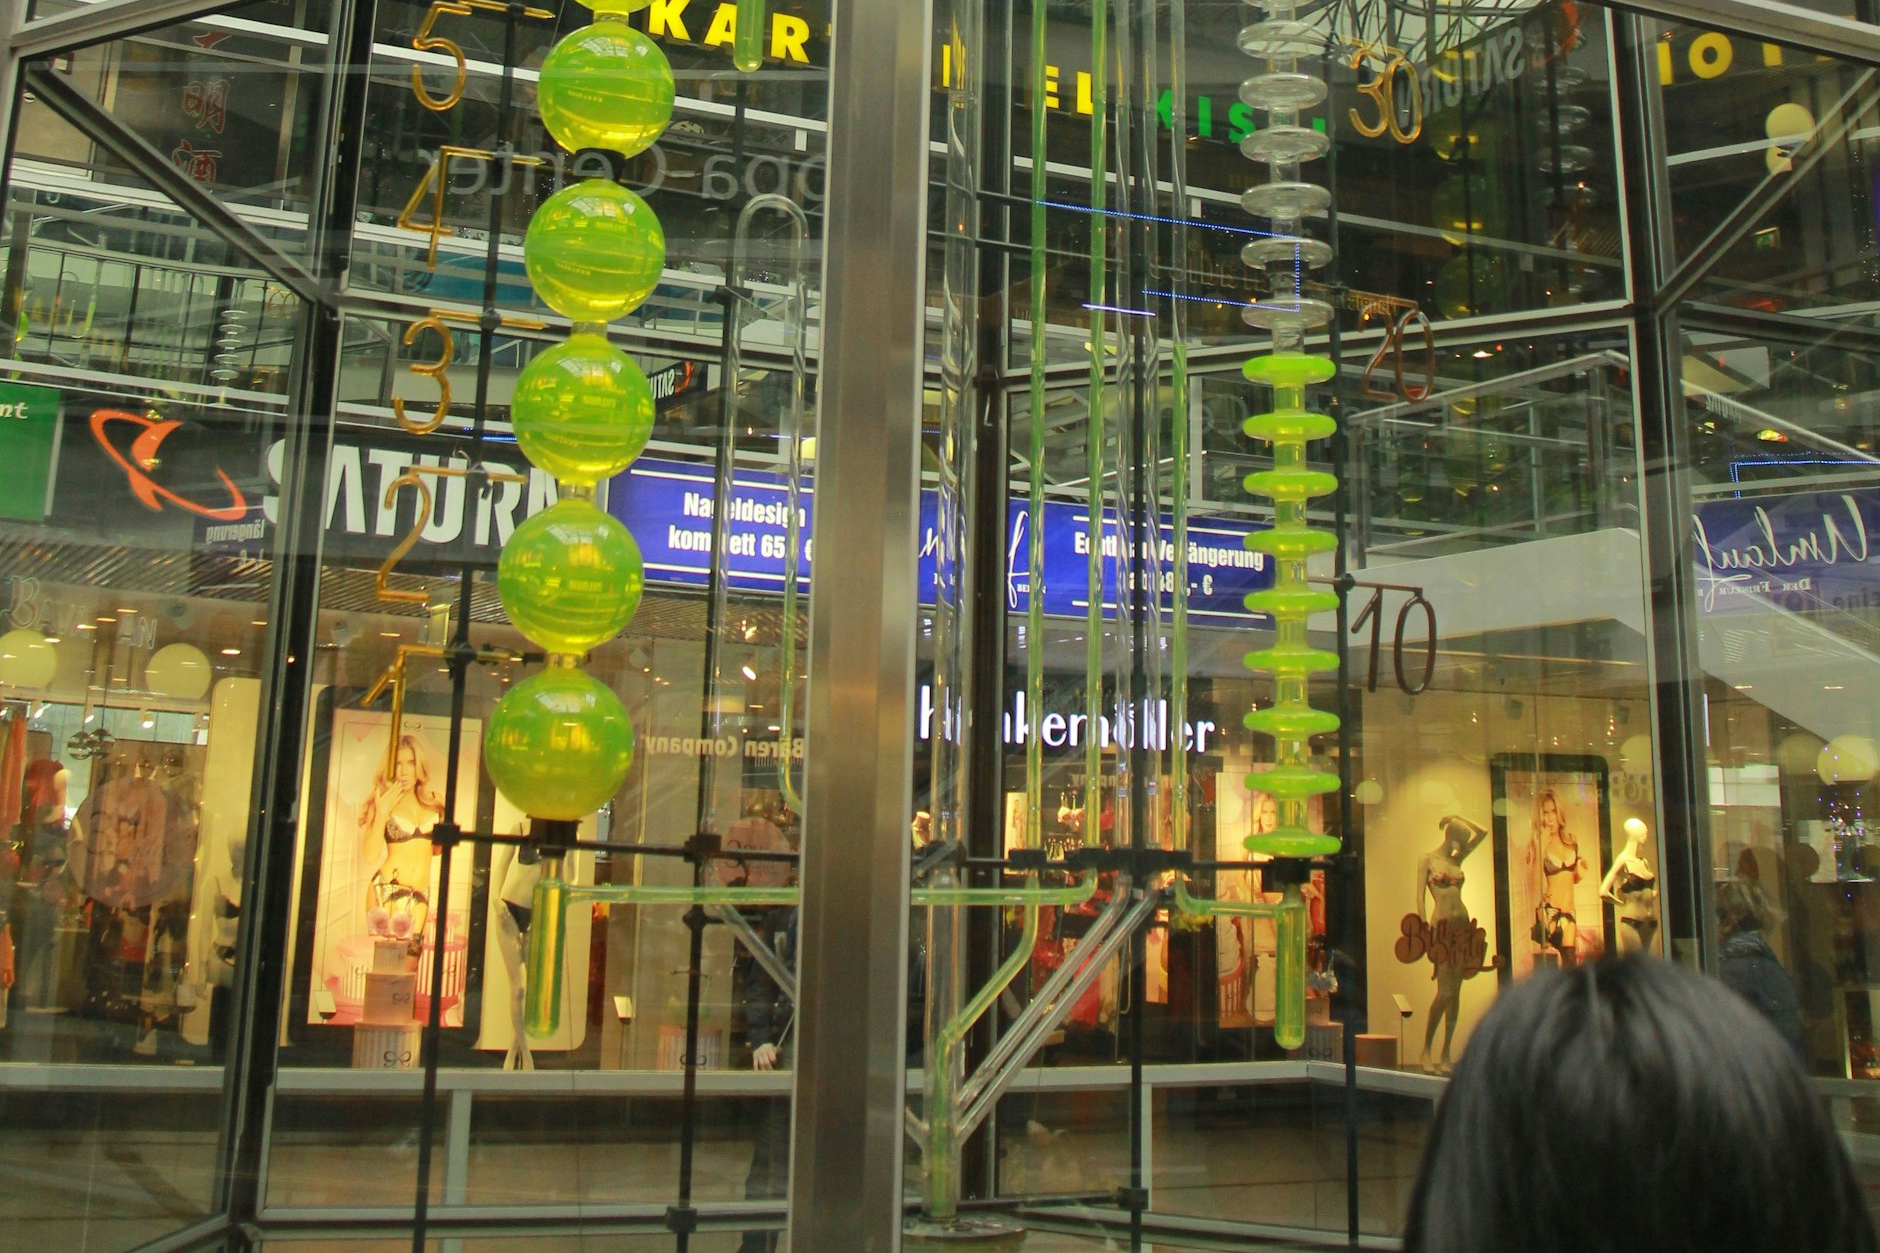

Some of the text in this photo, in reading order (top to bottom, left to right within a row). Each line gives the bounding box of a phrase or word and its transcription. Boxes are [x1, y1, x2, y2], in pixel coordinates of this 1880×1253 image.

[412, 1, 472, 111] 5
[1349, 48, 1423, 145] 30
[398, 147, 453, 271] 4
[395, 315, 454, 436] 3
[1357, 307, 1436, 406] 20
[376, 474, 431, 602] 2
[1351, 583, 1438, 695] 10
[361, 646, 406, 783] 1
